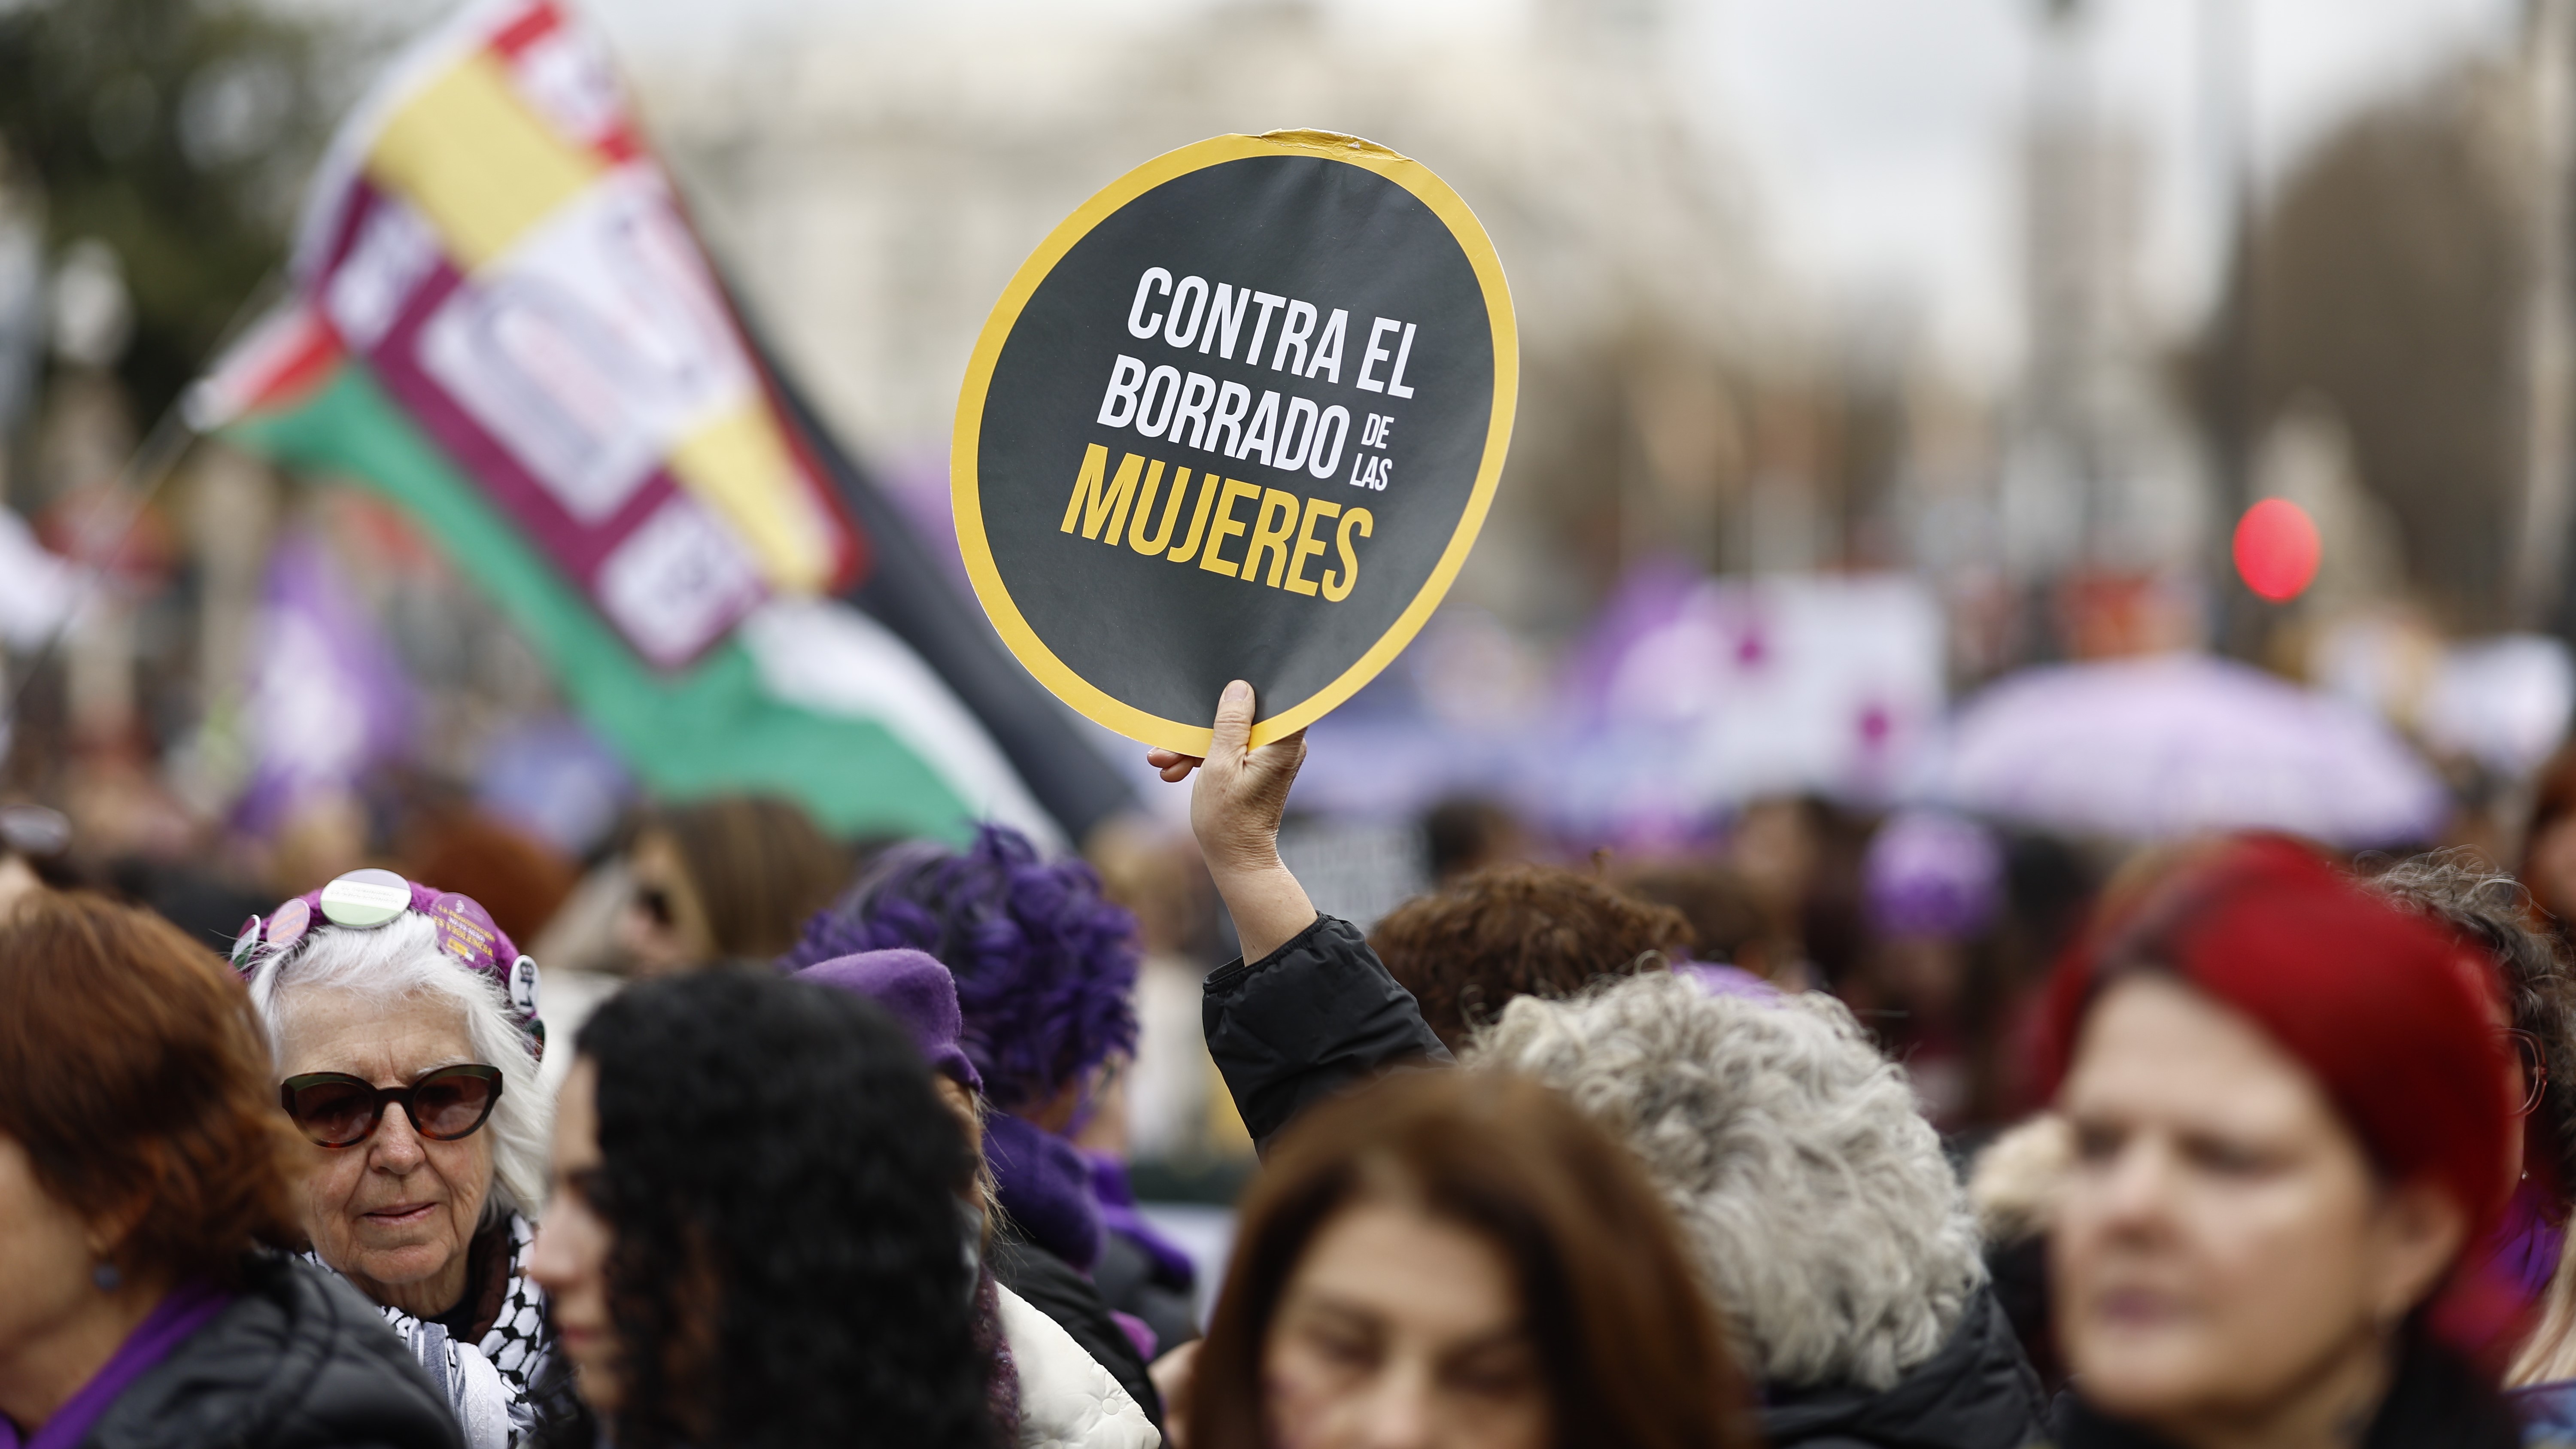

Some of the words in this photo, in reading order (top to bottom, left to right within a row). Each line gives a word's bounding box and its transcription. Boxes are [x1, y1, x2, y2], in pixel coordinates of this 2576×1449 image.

[1128, 267, 1348, 383] CONTRA
[1356, 317, 1416, 399] EL
[1097, 354, 1350, 478] BORRADO
[1361, 413, 1394, 449] DE
[1350, 453, 1392, 491] LAS
[1060, 443, 1373, 602] MUJERES
[433, 915, 445, 928] ES
[446, 922, 493, 958] VIOLENCIA
